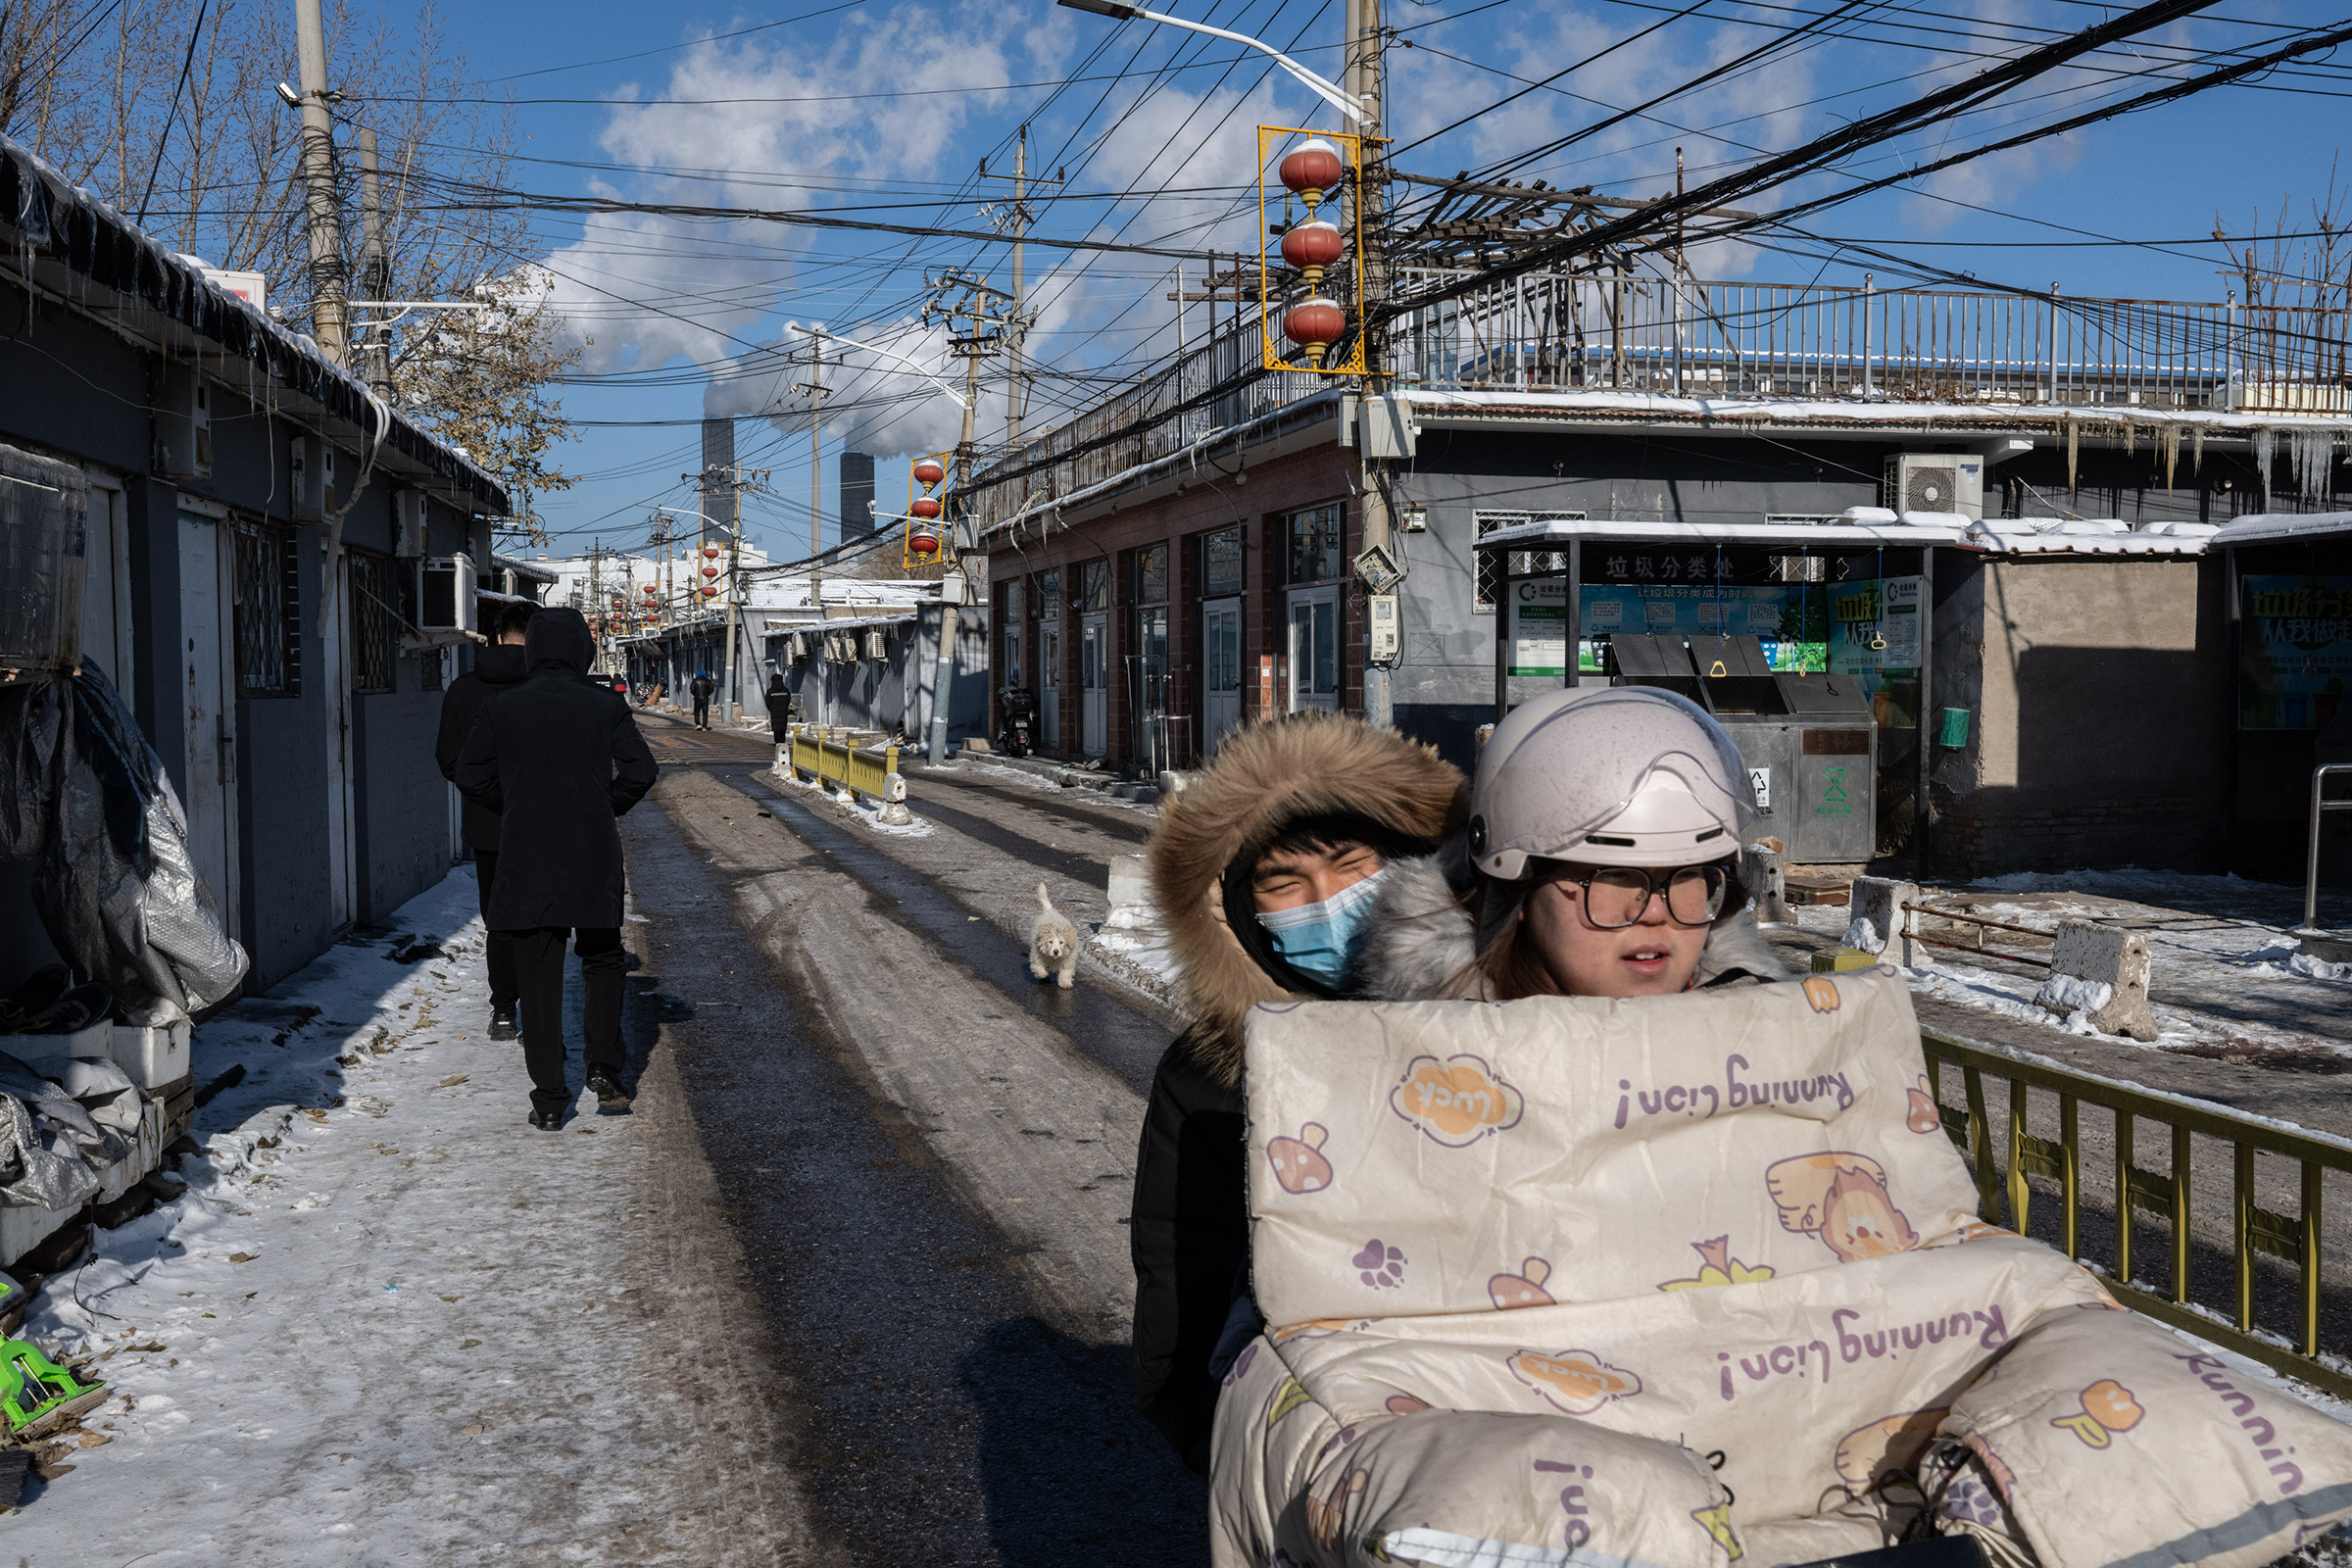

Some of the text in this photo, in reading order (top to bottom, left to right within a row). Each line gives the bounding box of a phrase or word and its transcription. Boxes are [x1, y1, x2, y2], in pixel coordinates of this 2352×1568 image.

[1606, 556, 1735, 579] 垃圾分类处
[1638, 588, 1753, 599] 让垃圾分类成为时尚
[2251, 588, 2352, 618] 垃圾分
[1414, 1081, 1492, 1120] Luck
[1614, 1054, 1855, 1130] Running Lion!
[1717, 1303, 2008, 1401] Running Lion!
[2173, 1352, 2305, 1495] Runnin
